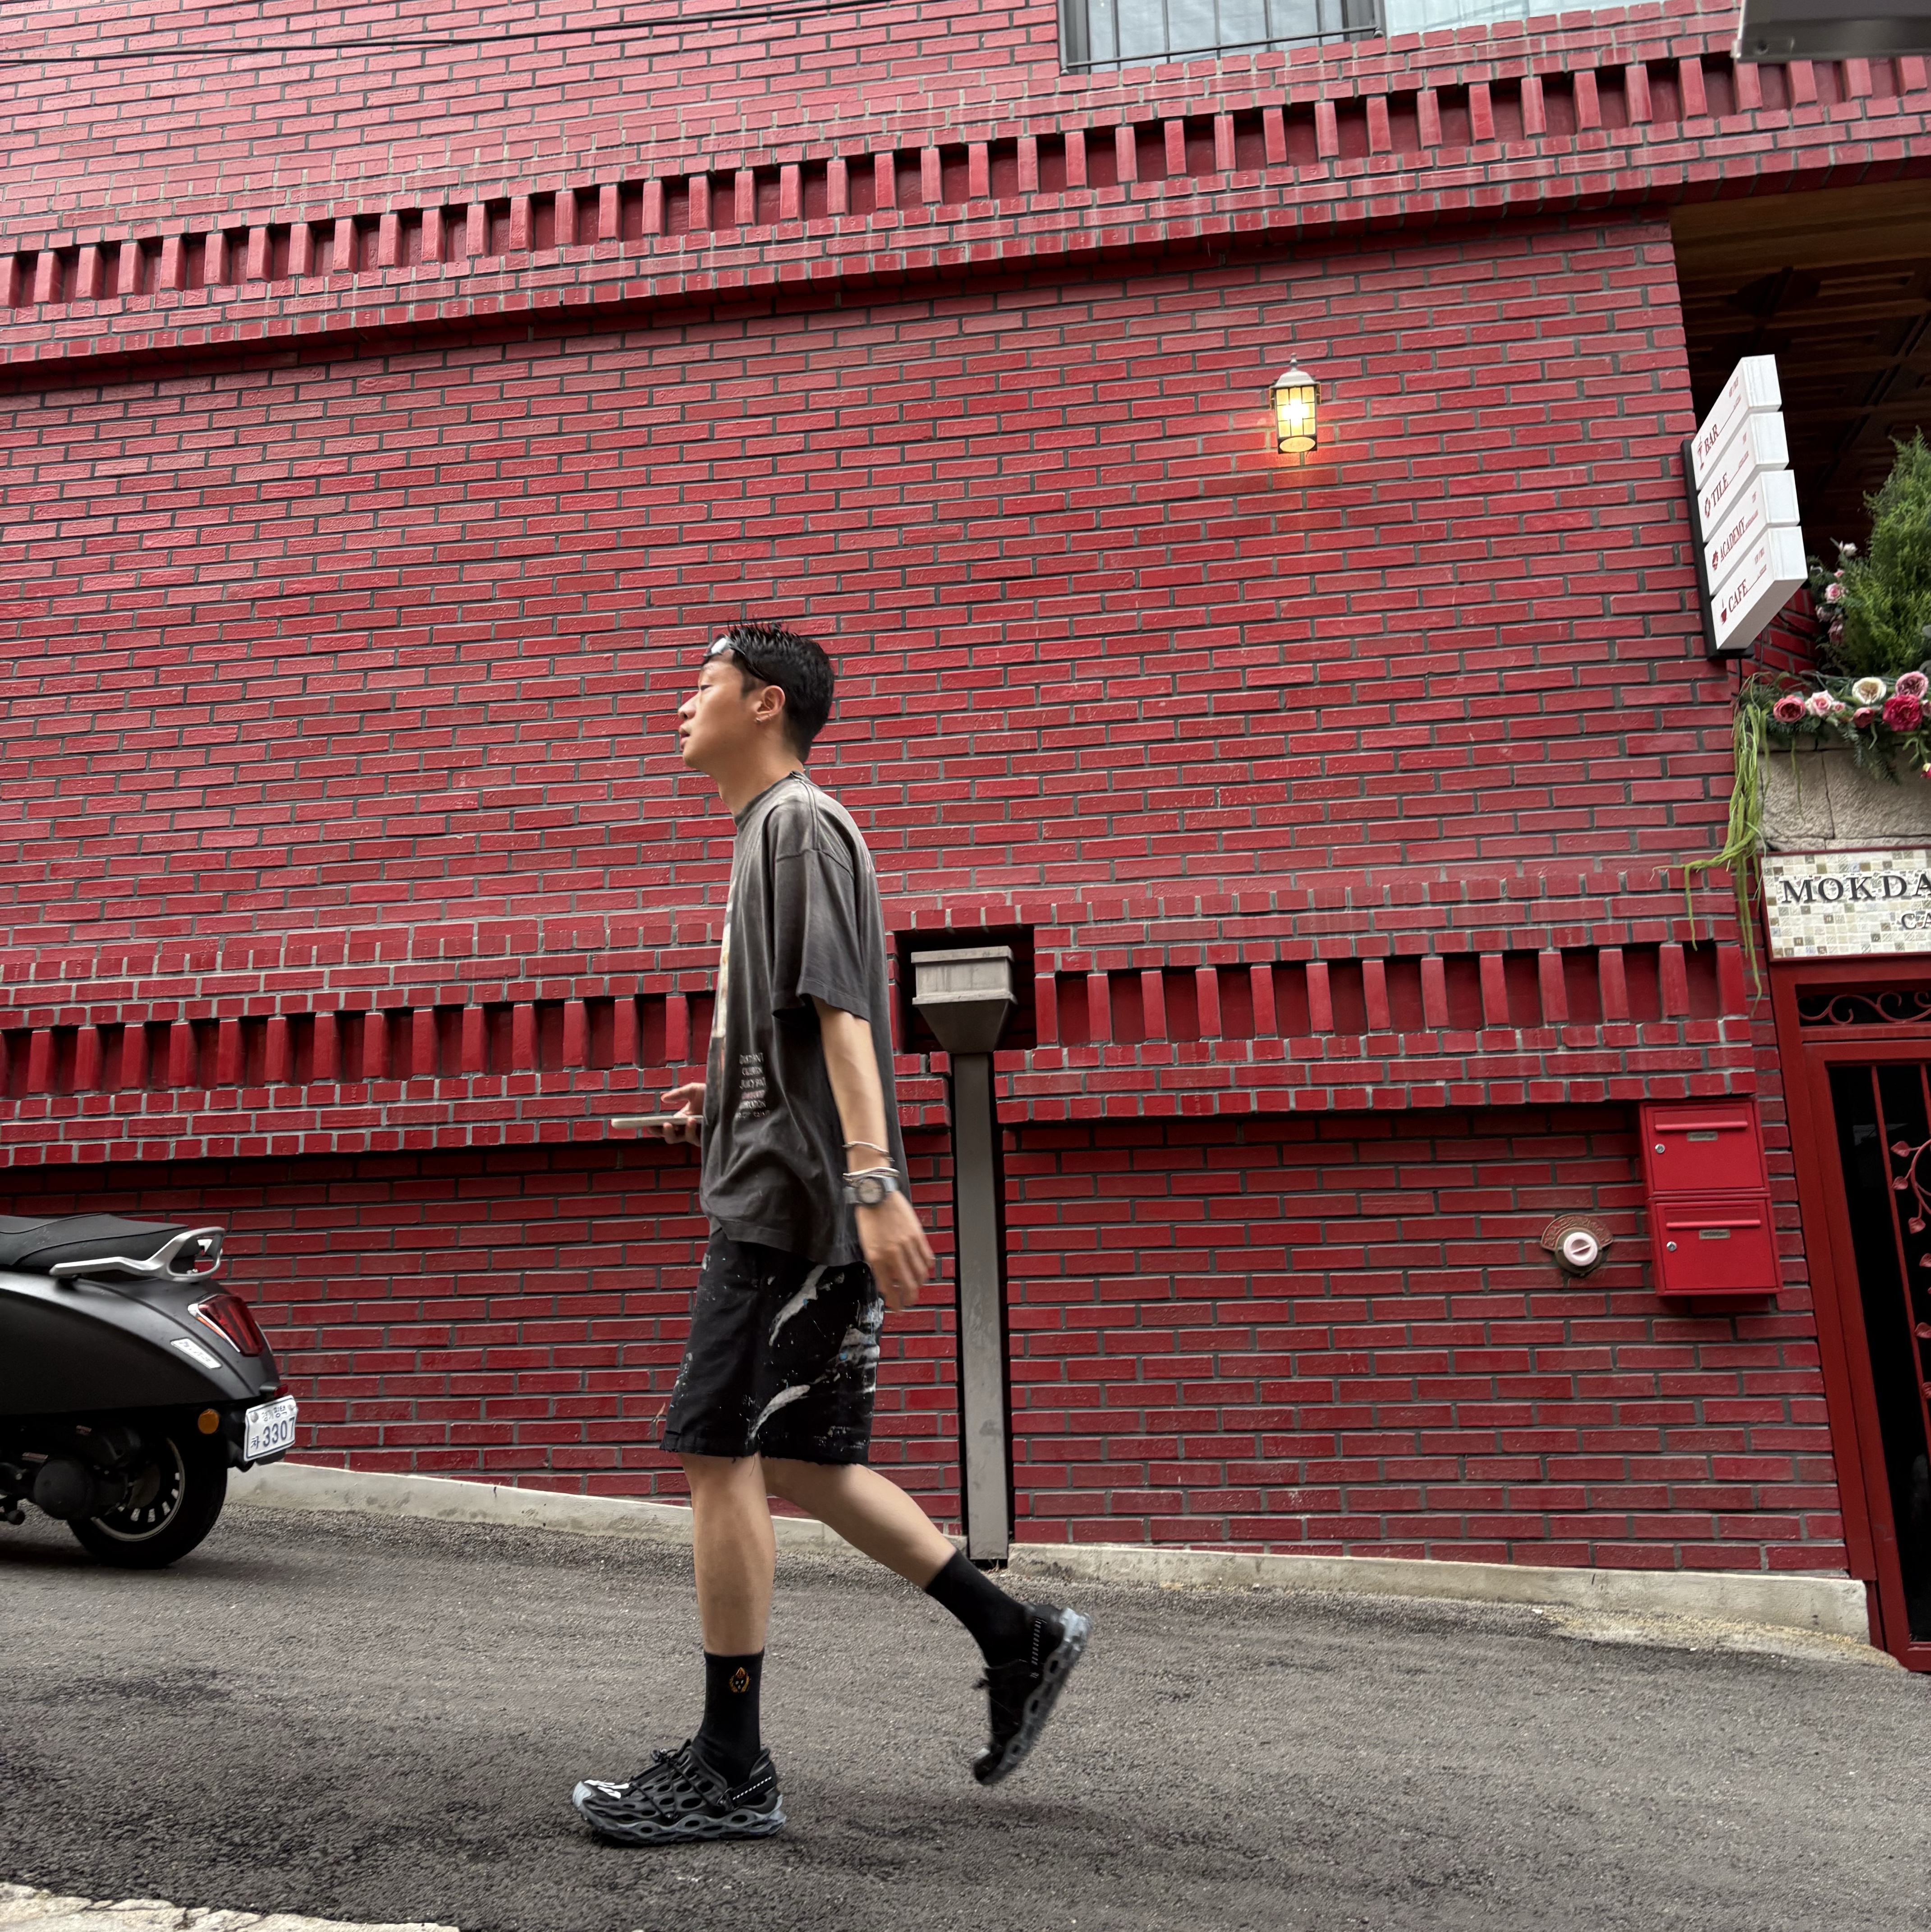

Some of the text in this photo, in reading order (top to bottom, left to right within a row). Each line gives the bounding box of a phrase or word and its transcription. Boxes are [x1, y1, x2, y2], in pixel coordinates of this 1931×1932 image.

[1704, 424, 1719, 455] BAR
[1711, 472, 1729, 508] TILE
[1720, 517, 1746, 562] ACADEMY
[1728, 578, 1750, 613] CAFE
[263, 1417, 295, 1447] 3307
